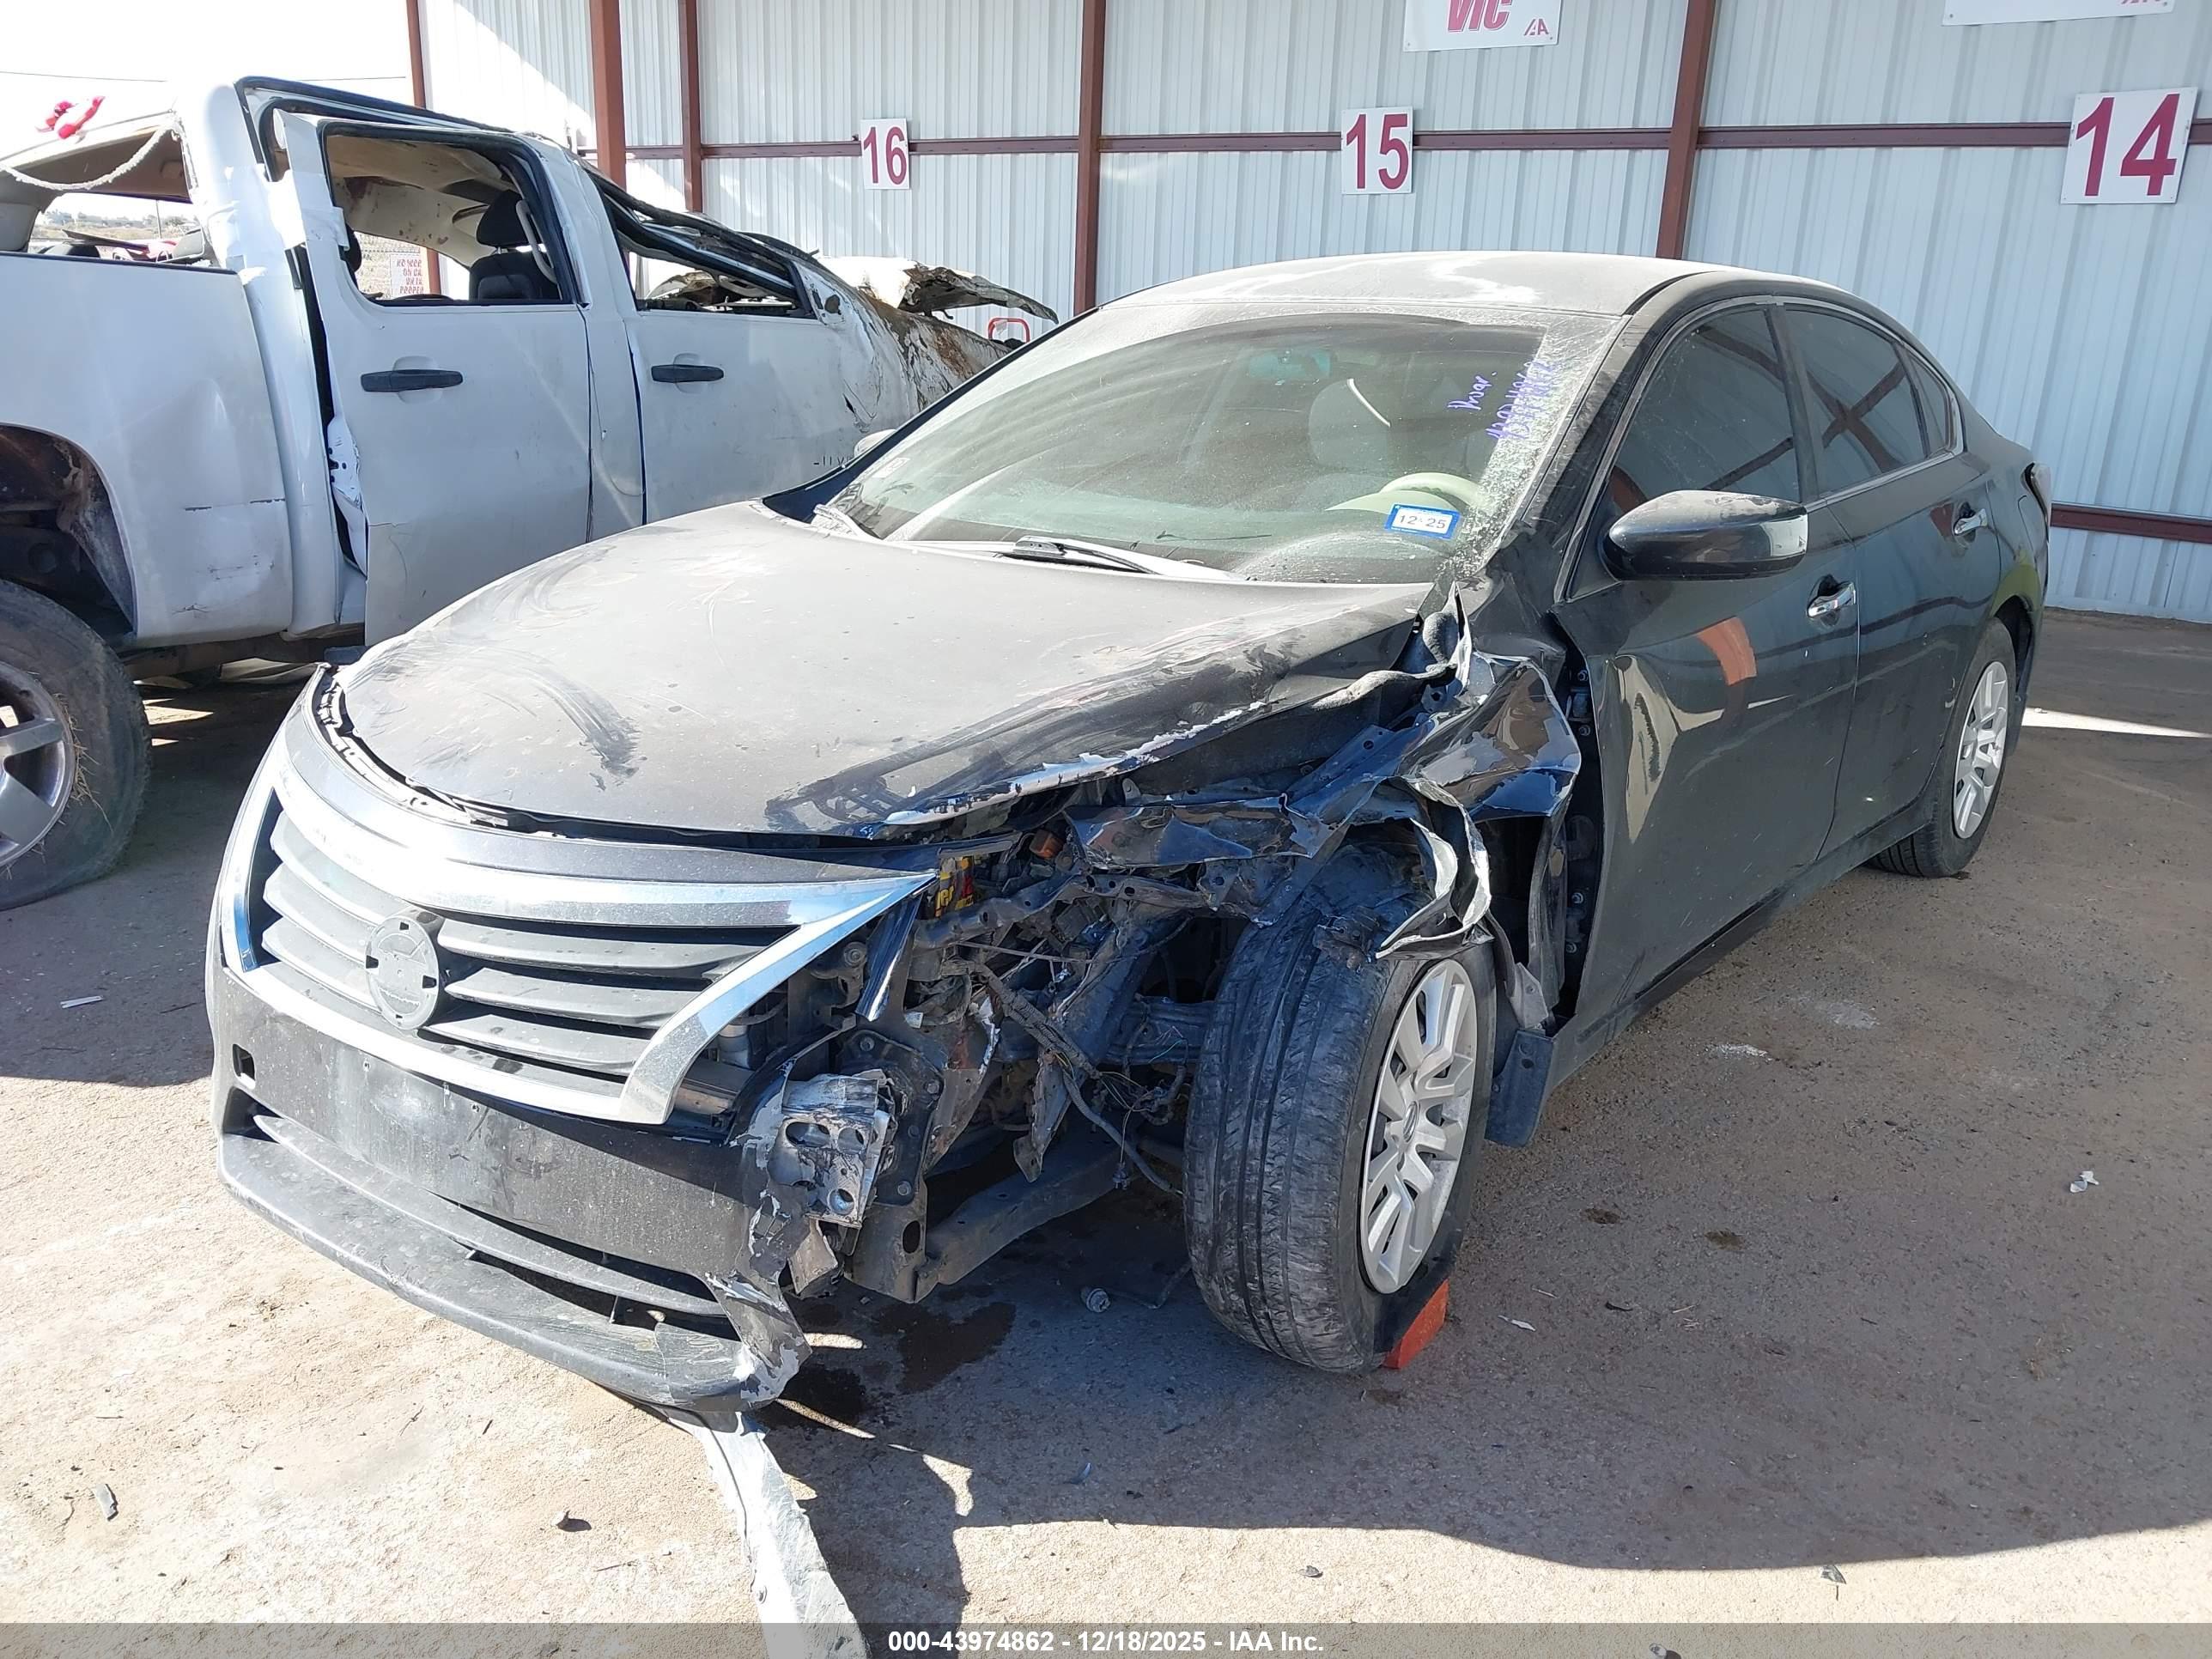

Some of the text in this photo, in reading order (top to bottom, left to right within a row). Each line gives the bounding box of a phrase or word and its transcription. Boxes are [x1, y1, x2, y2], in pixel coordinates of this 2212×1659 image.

[863, 126, 907, 185] 16
[1346, 113, 1409, 190] 15
[2075, 94, 2181, 197] 14
[1426, 518, 1447, 529] 25
